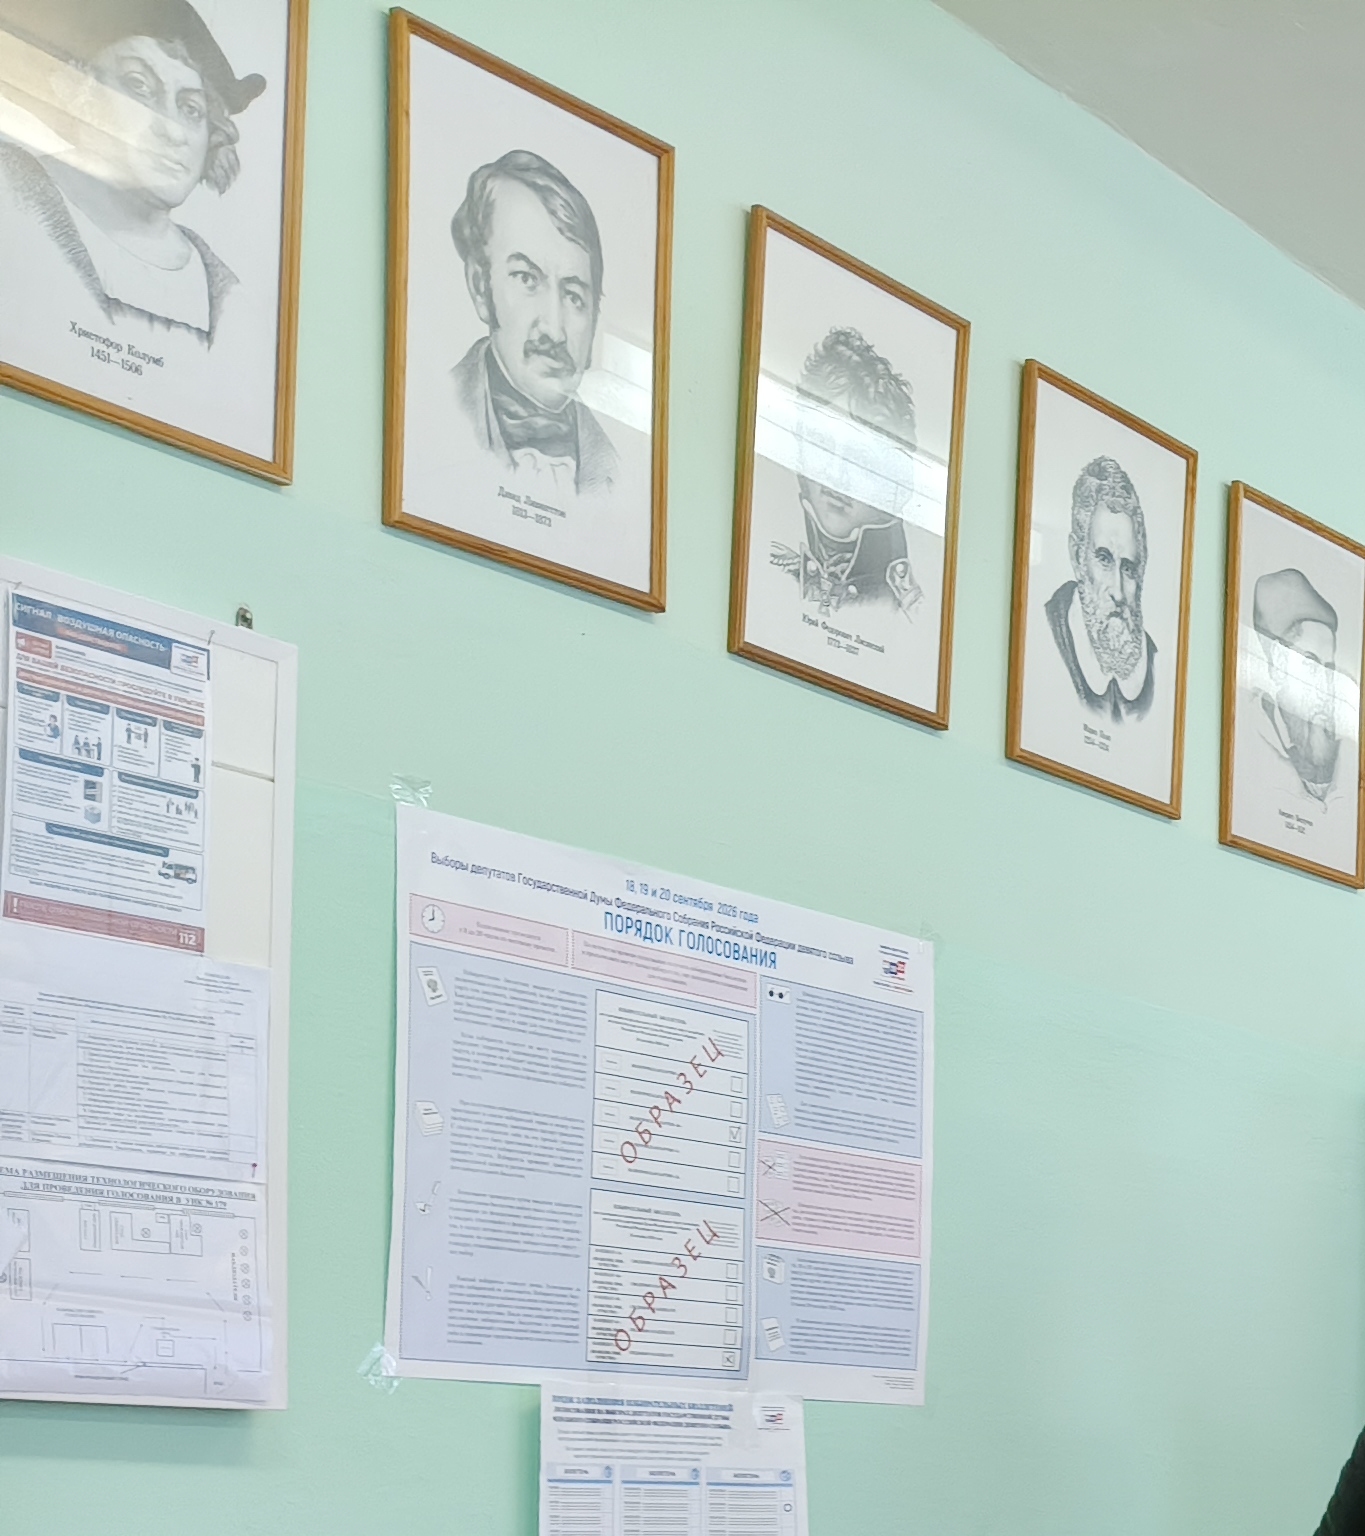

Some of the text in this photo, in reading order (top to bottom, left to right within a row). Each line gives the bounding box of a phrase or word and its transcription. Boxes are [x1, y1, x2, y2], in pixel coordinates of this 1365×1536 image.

[127, 344, 165, 368] Колумб
[15, 602, 52, 619] СИГНАЛ
[431, 851, 469, 871] Выборы
[470, 864, 516, 882] депутатов
[517, 872, 588, 900] Государственной
[589, 891, 613, 906] Думы
[615, 897, 671, 920] Федерального
[673, 911, 709, 929] Собрания
[710, 920, 754, 940] Российской
[755, 931, 796, 950] Федерации
[651, 888, 657, 897] и
[659, 887, 671, 901] 20
[672, 893, 714, 911] сентября
[717, 902, 738, 917] 2026
[739, 910, 759, 923] года
[178, 932, 197, 946] 112
[604, 911, 674, 946] ПОРЯДОК
[678, 929, 777, 970] ГОЛОСОВАНИЯ
[619, 1036, 725, 1165] ОБРАЗЕЦ
[613, 1218, 721, 1352] ОБРАЗЕЦ
